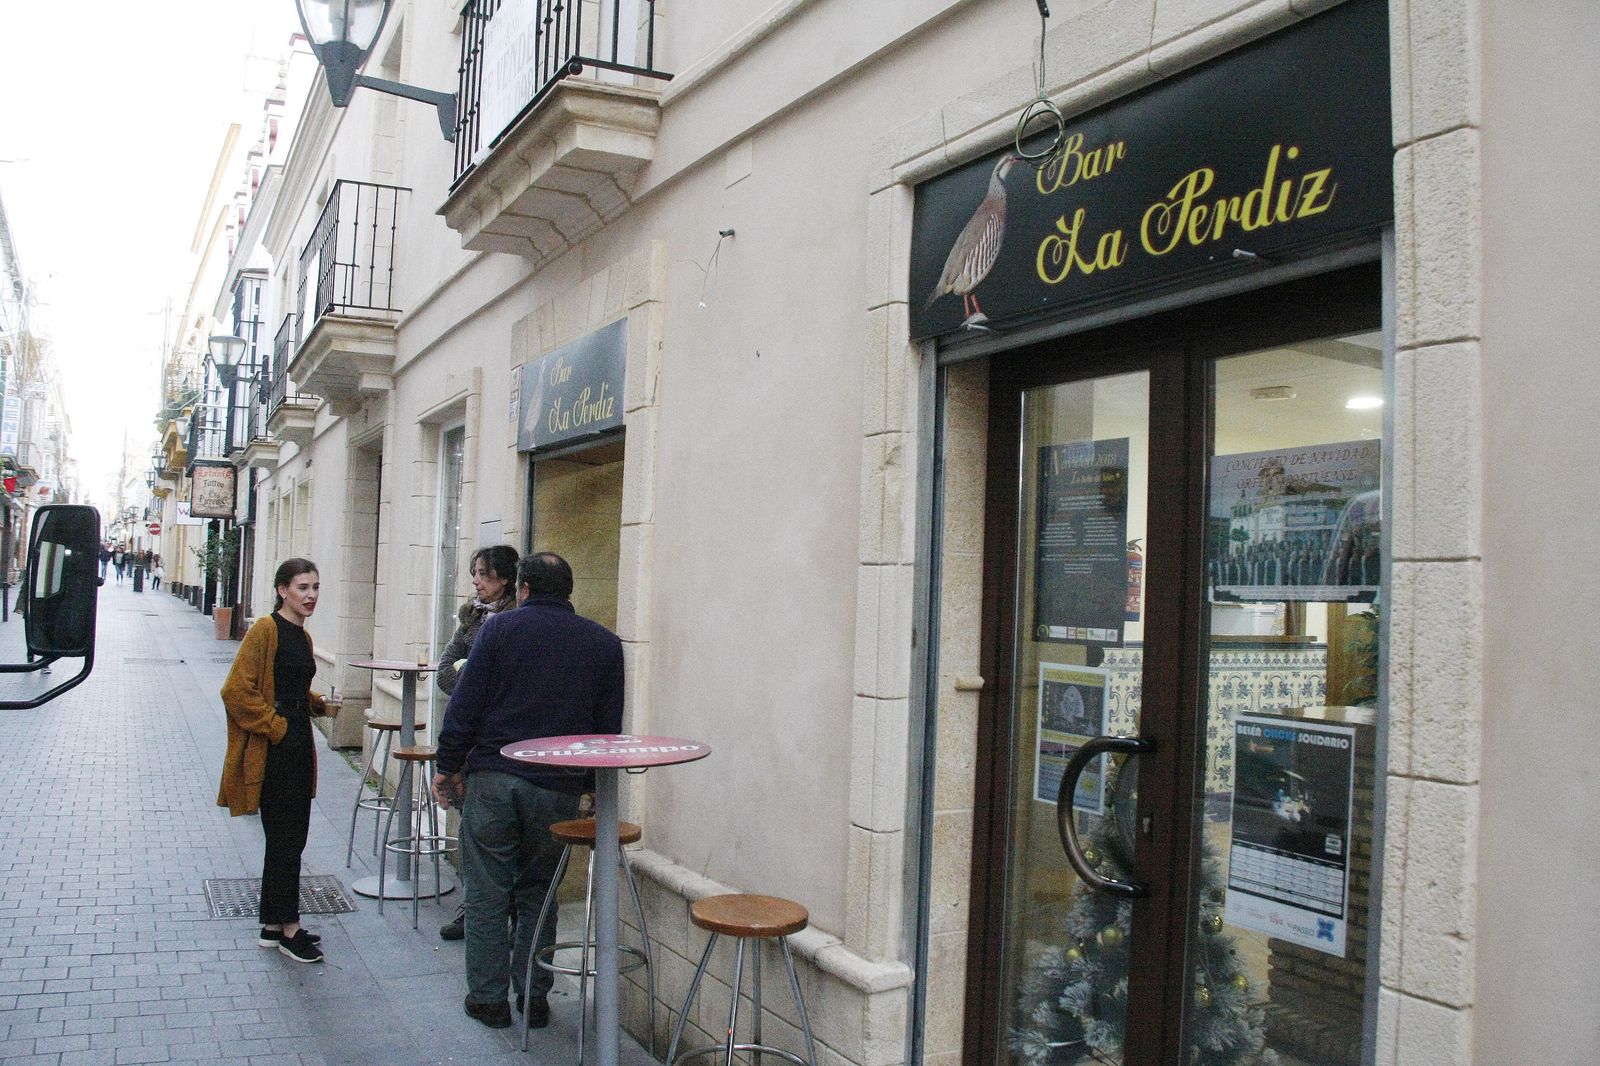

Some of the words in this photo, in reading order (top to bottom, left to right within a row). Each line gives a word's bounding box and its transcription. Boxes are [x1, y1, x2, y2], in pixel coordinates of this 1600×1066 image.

[1036, 131, 1127, 195] Bar
[1036, 208, 1128, 284] La
[1140, 144, 1339, 256] Perdiz
[548, 396, 569, 434] La
[573, 381, 615, 427] Perdiz
[1290, 452, 1305, 466] DE
[1308, 447, 1370, 465] NAVIDAD
[513, 744, 700, 758] Cruzcampo
[1237, 723, 1262, 737] BELÉN
[1298, 732, 1349, 749] SOLIDARIO
